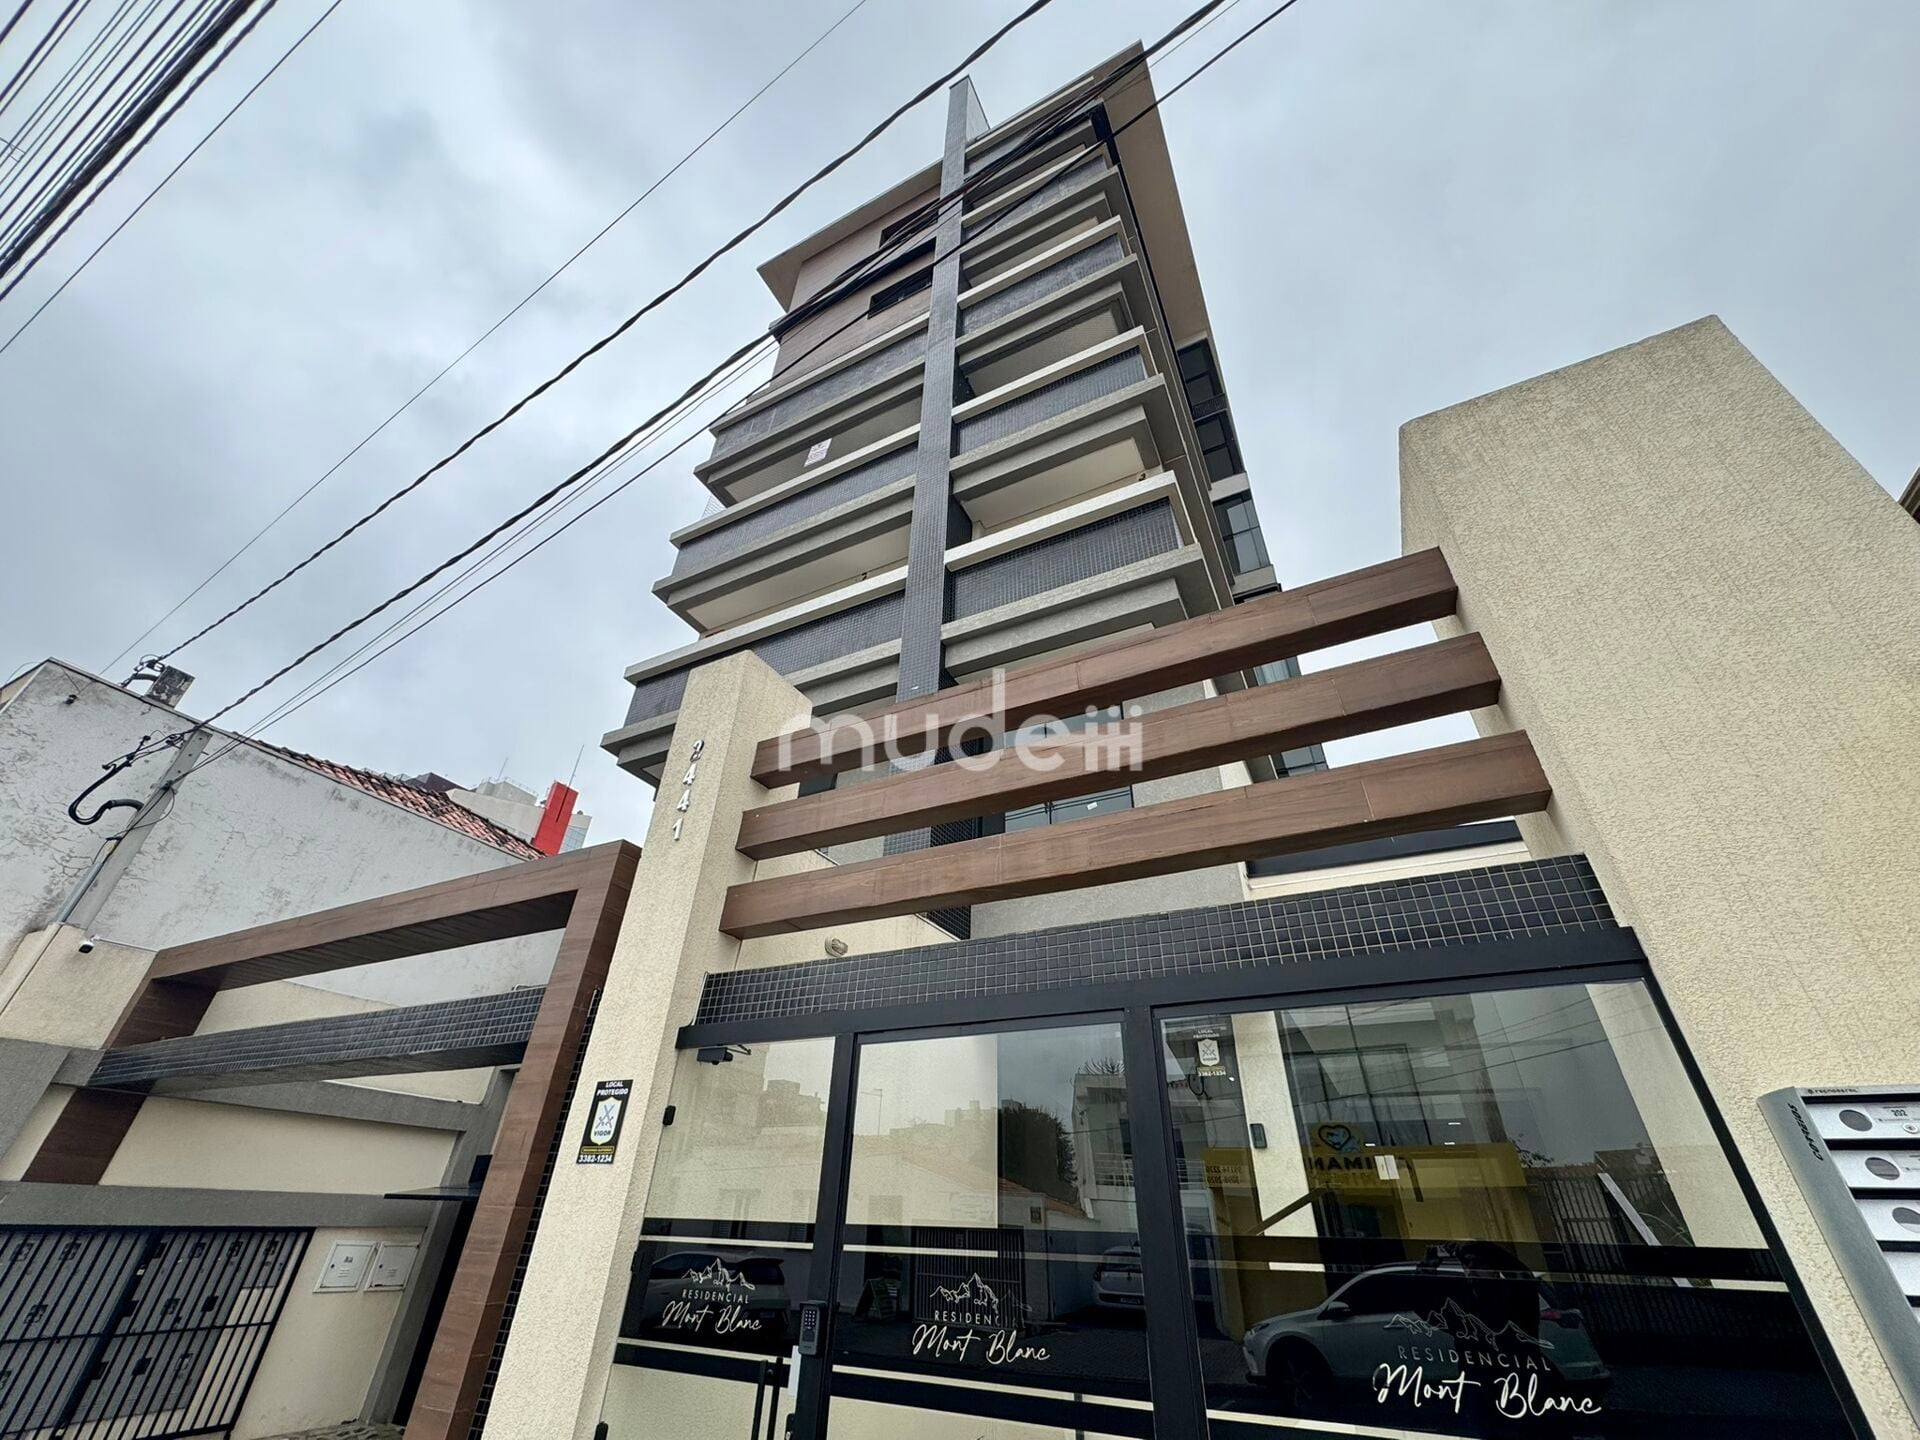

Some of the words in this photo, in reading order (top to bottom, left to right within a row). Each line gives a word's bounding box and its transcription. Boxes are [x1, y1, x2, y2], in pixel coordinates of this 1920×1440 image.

[672, 739, 705, 841] 2441
[596, 1088, 629, 1096] PROTEGIDO
[578, 1154, 613, 1163] 3382-1234
[682, 1289, 750, 1304] RESIDENCIAL
[662, 1300, 714, 1332] Mont
[715, 1304, 762, 1334] Blanc
[912, 1324, 981, 1362] Mont
[986, 1329, 1051, 1365] Blanc
[1398, 1345, 1551, 1371] RESIDENCIAL
[1373, 1363, 1481, 1413] Mont
[1494, 1372, 1602, 1418] Blanc
